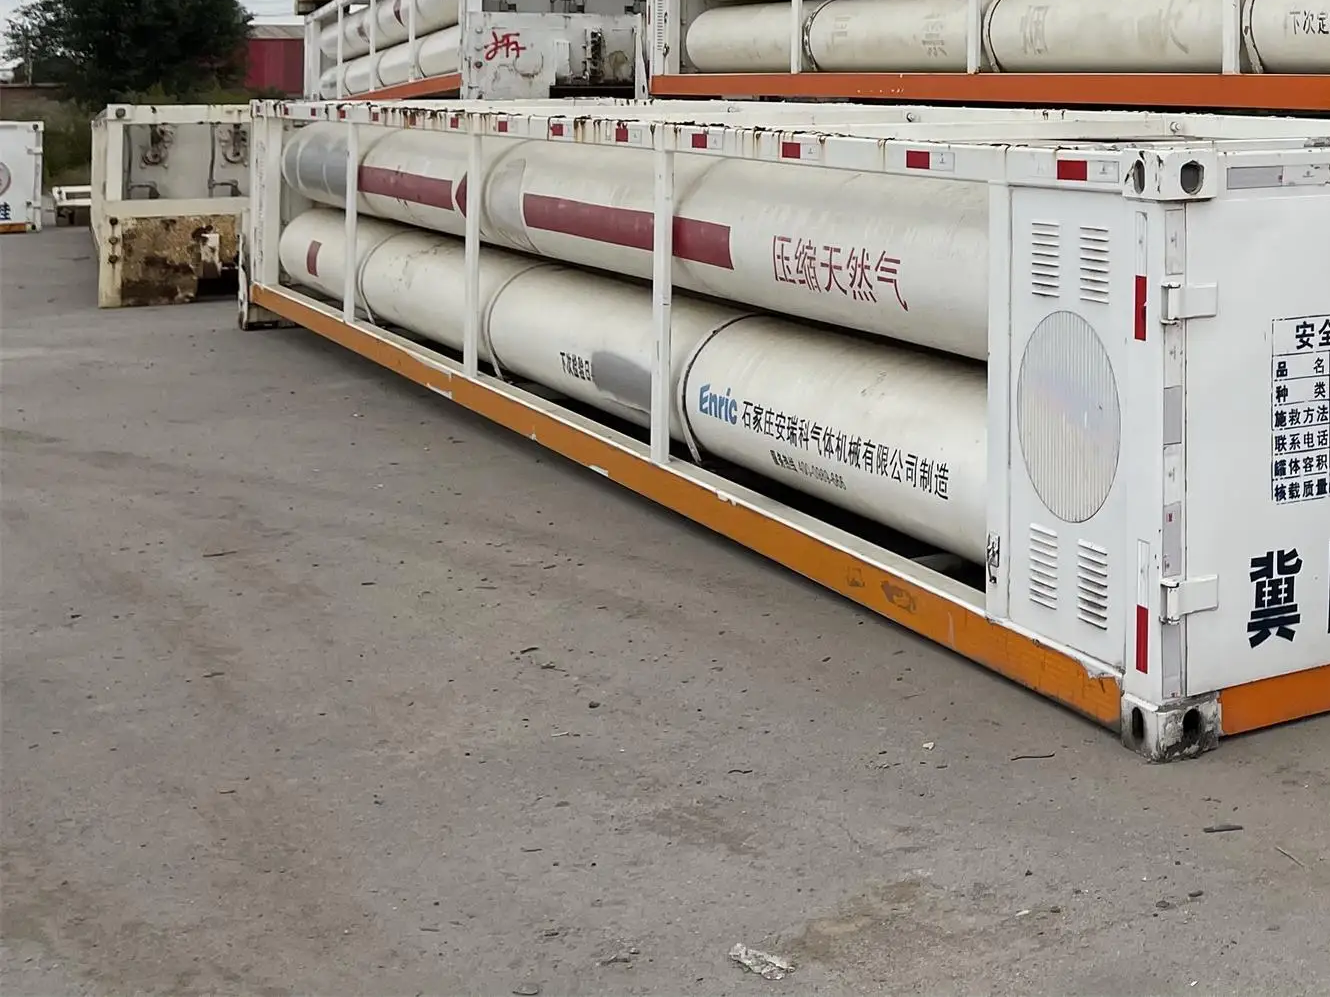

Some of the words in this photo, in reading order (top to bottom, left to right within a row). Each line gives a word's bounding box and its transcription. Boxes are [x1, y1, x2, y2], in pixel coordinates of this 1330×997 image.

[773, 235, 909, 312] 压缩天然气
[560, 351, 594, 382] 下次检验日
[1276, 357, 1325, 378] 品名
[1275, 381, 1327, 403] 种类
[1275, 404, 1329, 428] 施救方法
[699, 383, 738, 426] Enric
[741, 400, 950, 500] 石家庄安瑞科气体机械有限公司制造
[1275, 429, 1329, 452] 联系电话
[1274, 454, 1328, 477] 罐体容积
[1274, 477, 1328, 502] 核载质量
